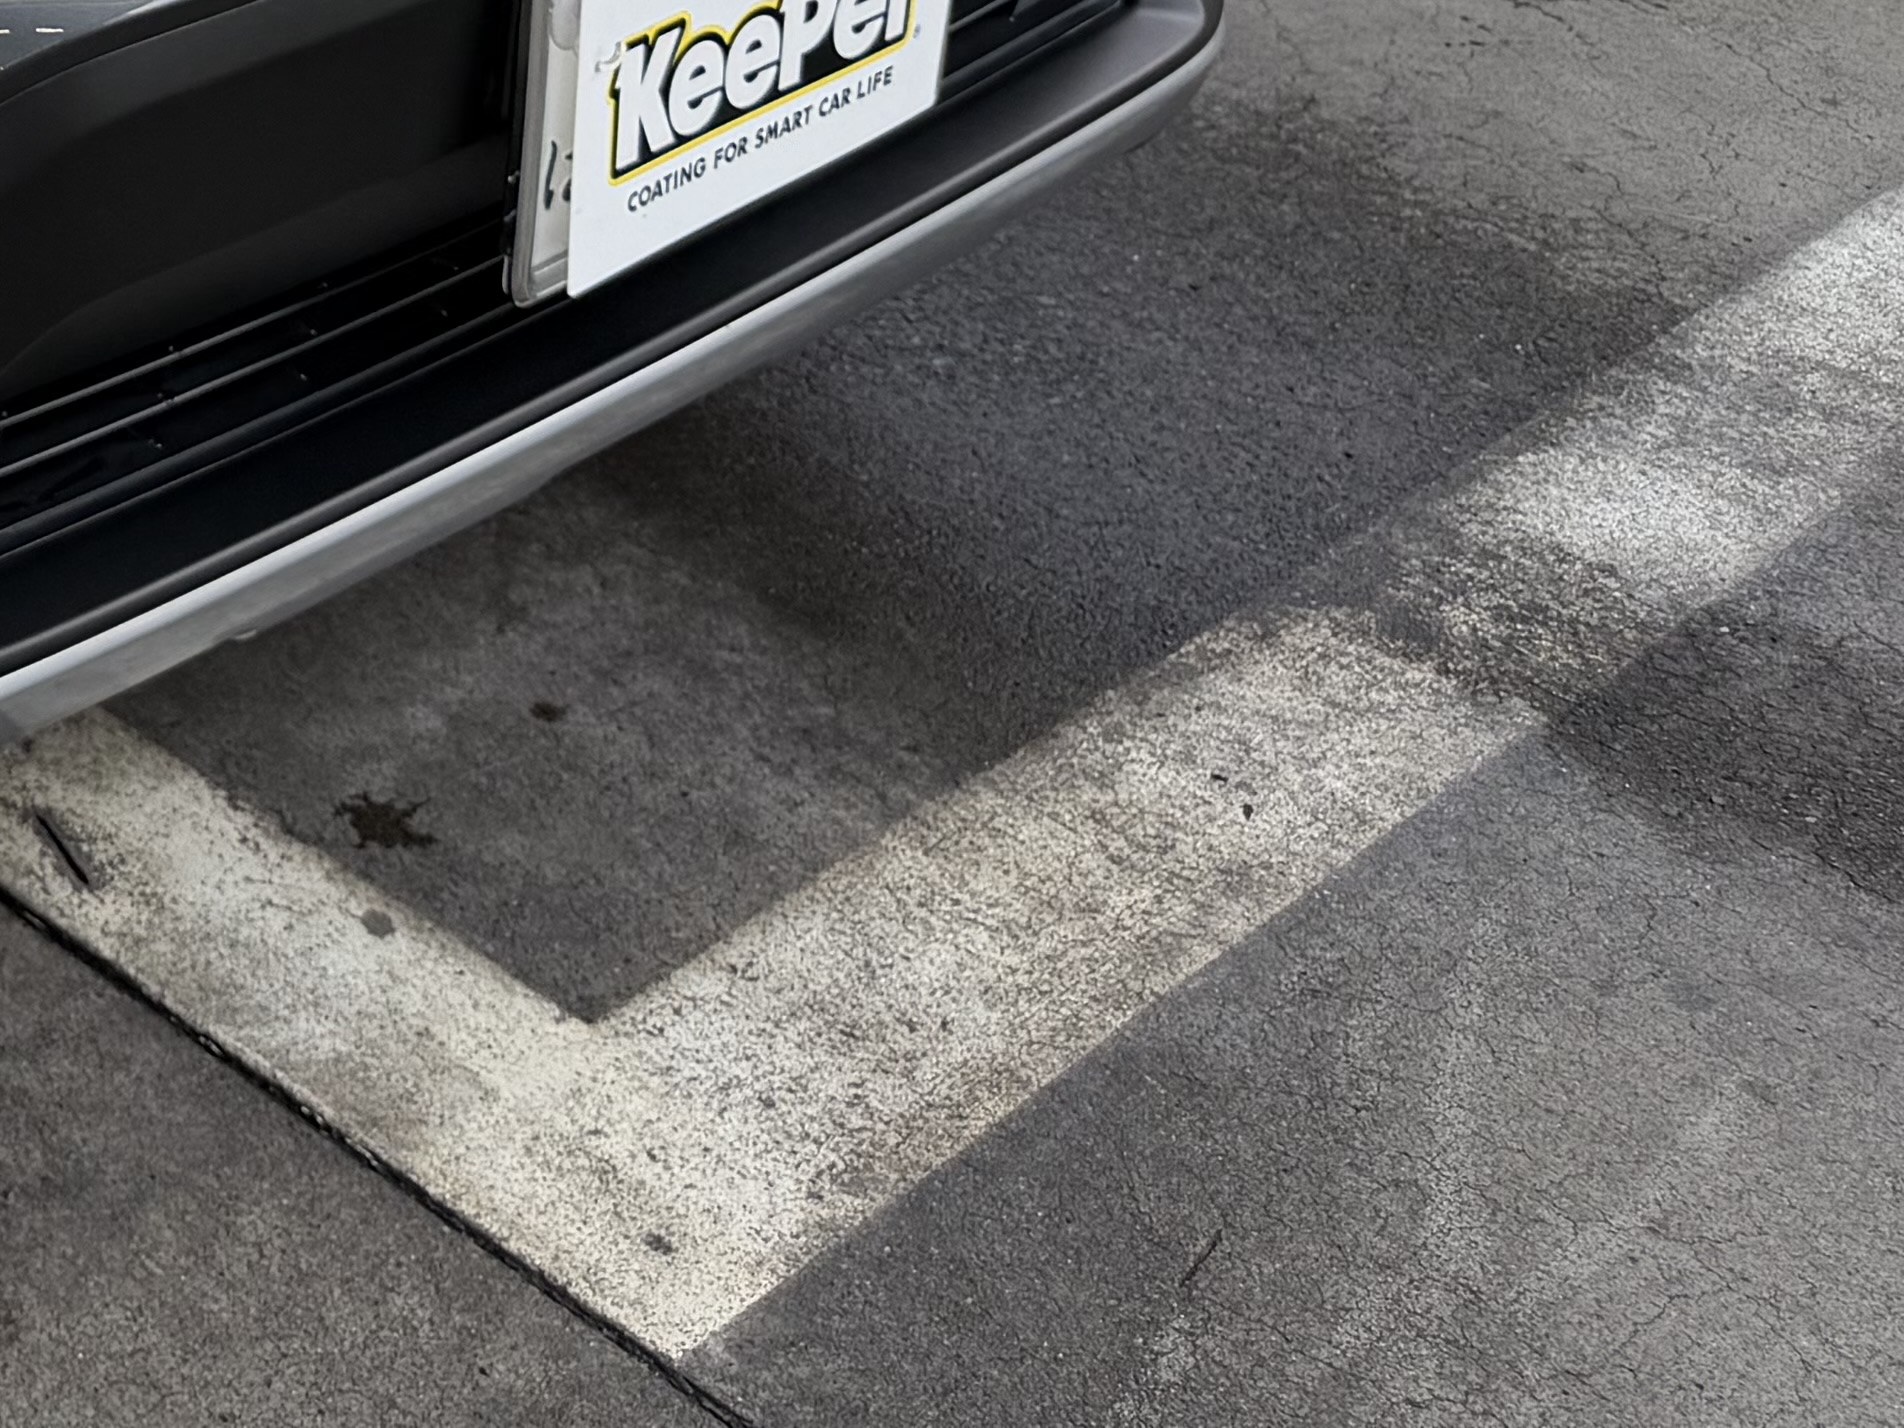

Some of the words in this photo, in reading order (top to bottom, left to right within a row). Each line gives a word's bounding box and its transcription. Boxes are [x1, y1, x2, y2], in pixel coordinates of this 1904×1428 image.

[627, 156, 707, 212] COATING
[713, 136, 749, 170] FOR
[754, 104, 814, 149] SMART
[818, 88, 852, 117] CAR
[856, 65, 894, 100] LIFE
